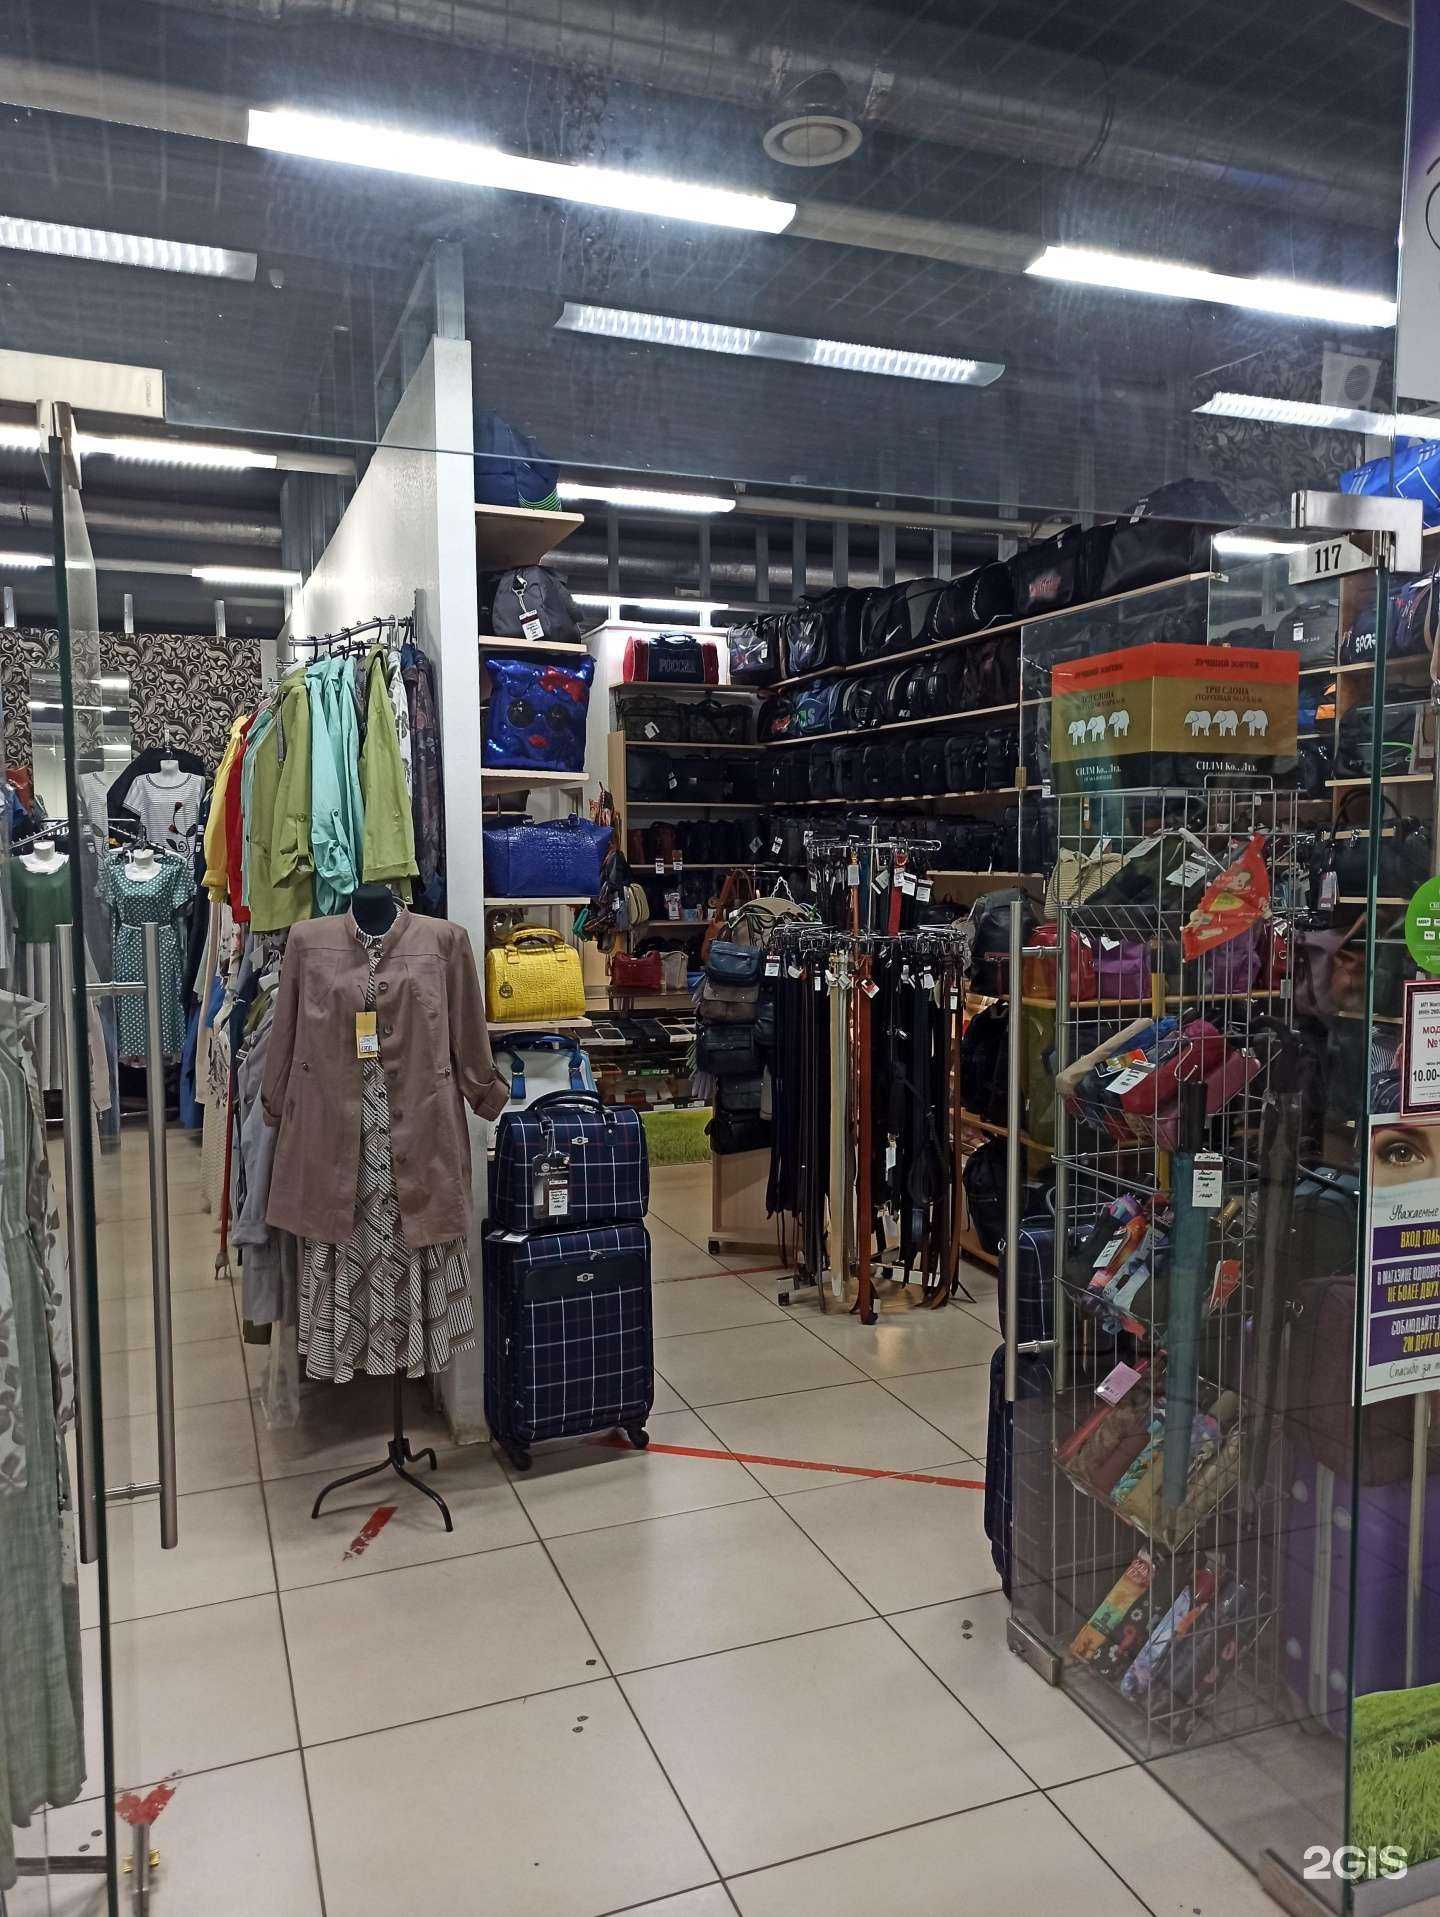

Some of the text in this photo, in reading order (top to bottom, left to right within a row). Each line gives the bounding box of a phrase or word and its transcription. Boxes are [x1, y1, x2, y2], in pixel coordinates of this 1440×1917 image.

[1315, 544, 1342, 573] 117
[1389, 1203, 1439, 1221] Уважаемые
[1400, 1230, 1421, 1248] ВХОД
[1382, 1267, 1412, 1285] МАГАЗИНЕ
[1387, 1281, 1439, 1303] НЕ БОЛЕЕ ДВУХ
[1391, 1315, 1437, 1336] СОБЛЮДАЙТЕ
[1403, 1336, 1413, 1353] 2М
[1414, 1332, 1433, 1352] ДРУГ
